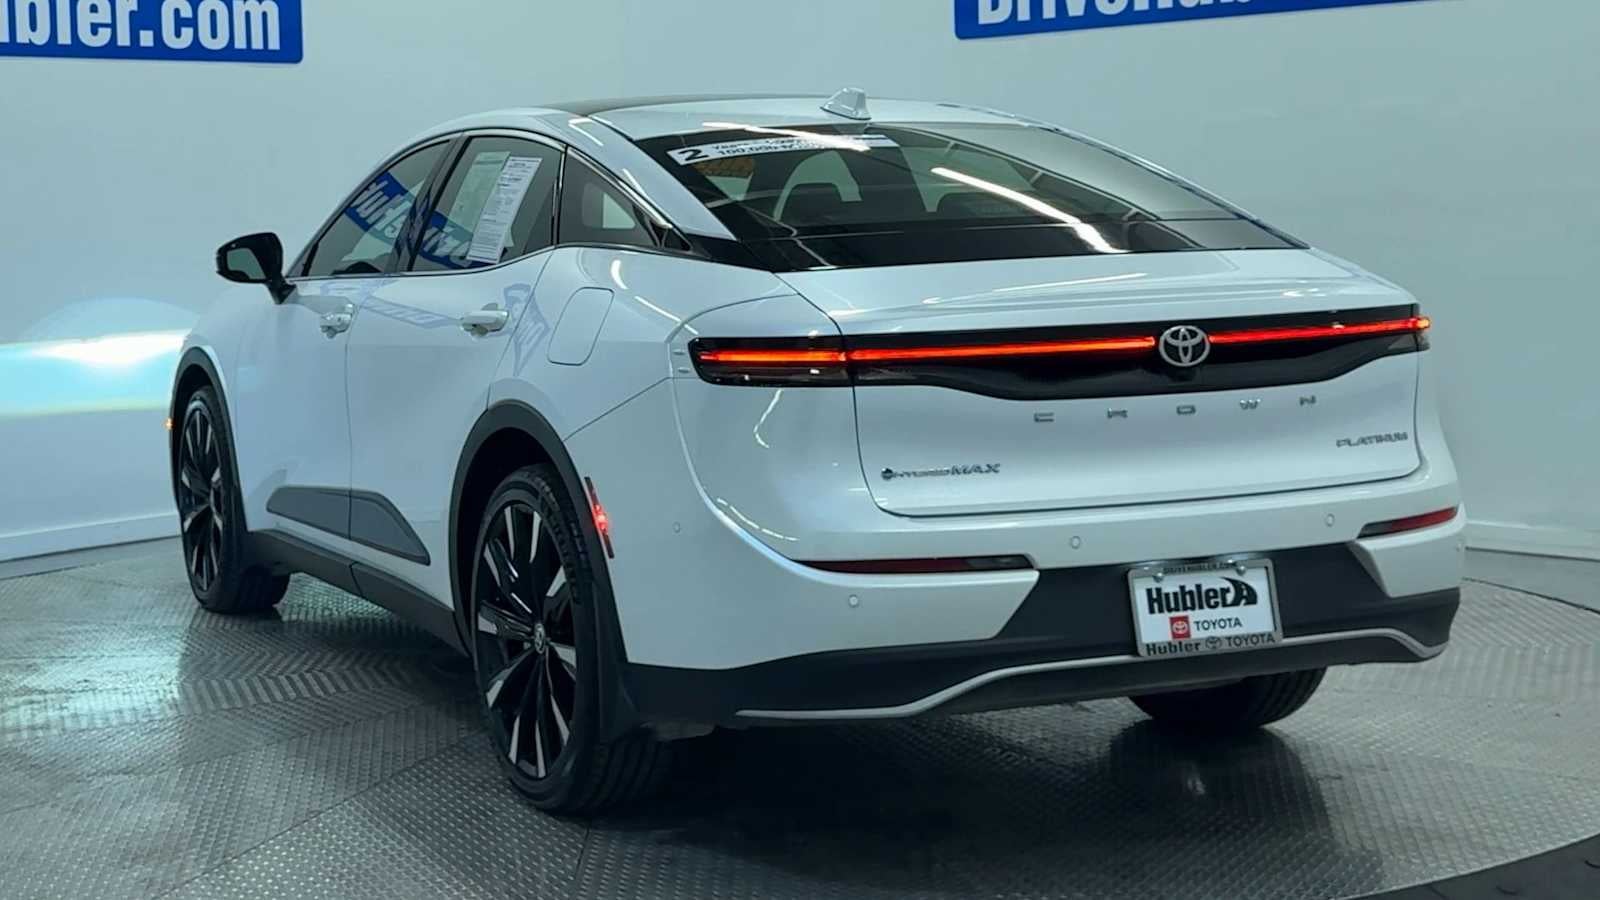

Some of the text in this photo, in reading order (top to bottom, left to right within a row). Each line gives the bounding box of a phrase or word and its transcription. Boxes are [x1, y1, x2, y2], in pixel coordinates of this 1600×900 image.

[678, 148, 709, 161] 2
[1335, 431, 1409, 448] PLATINUM
[1146, 583, 1232, 615] Hubler
[1194, 617, 1243, 632] TOYOTA
[1146, 632, 1276, 657] Hubler TOYOTA
